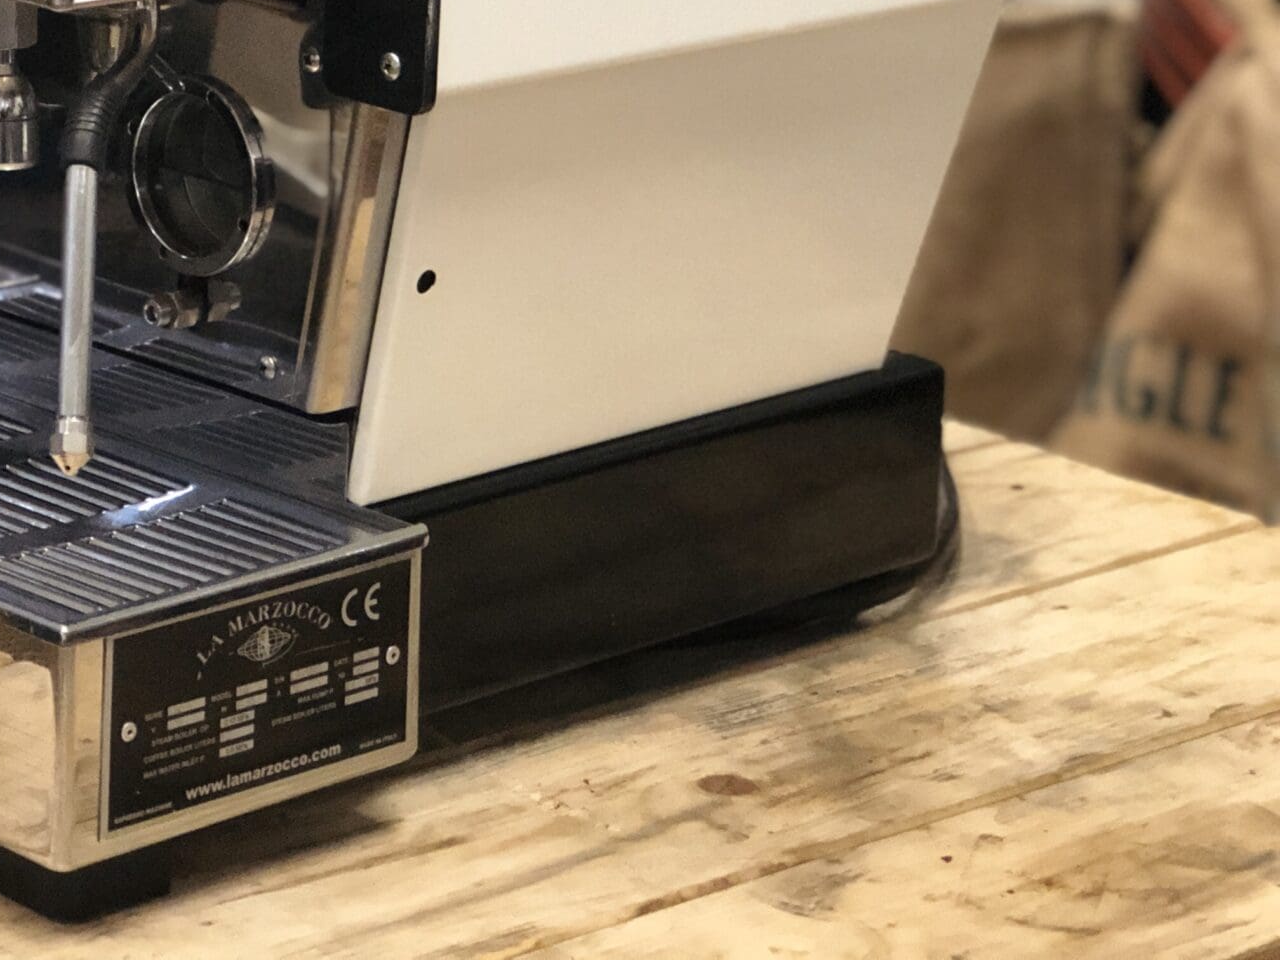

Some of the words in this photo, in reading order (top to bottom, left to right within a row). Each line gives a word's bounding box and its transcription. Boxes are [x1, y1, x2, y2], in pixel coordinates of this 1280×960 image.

[196, 634, 225, 666] LA
[228, 600, 332, 638] MARZOCCO
[185, 742, 343, 801] www.lamarzocco.com
